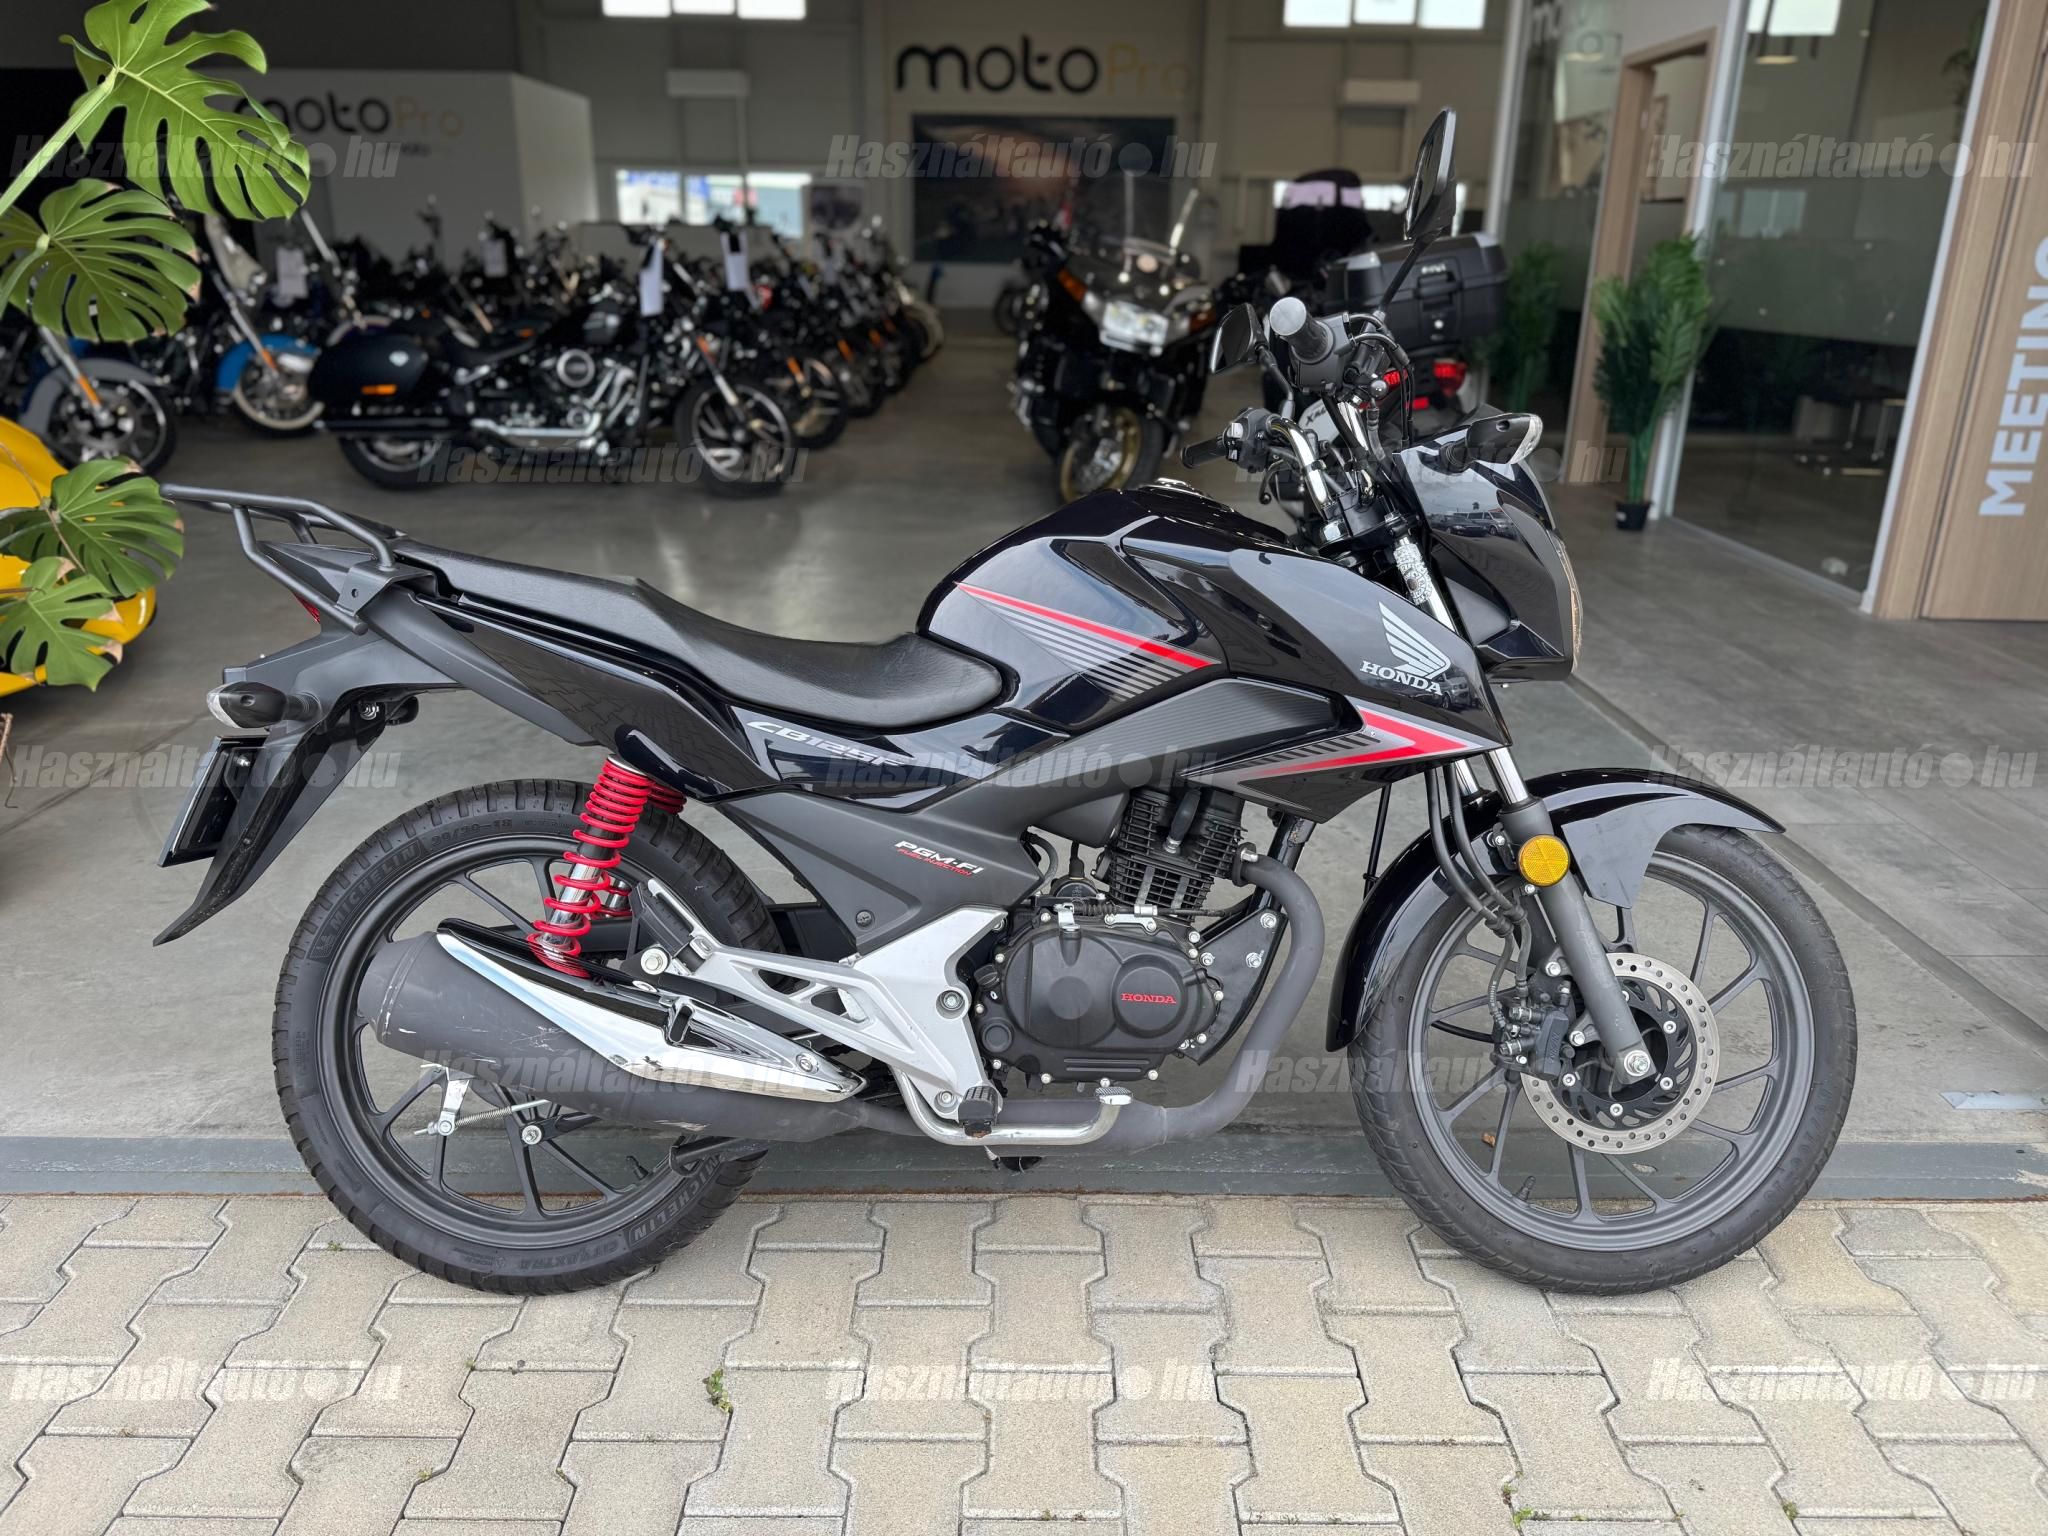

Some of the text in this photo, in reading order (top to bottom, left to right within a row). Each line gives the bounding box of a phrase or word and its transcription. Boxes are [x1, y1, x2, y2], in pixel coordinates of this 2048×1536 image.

[1979, 237, 2048, 516] MEETIN
[1360, 660, 1443, 696] HONDA
[747, 721, 905, 767] CB125F
[330, 842, 420, 931] MICHELIN
[1121, 993, 1177, 1004] HONDA
[634, 1154, 724, 1242] MICHELIN
